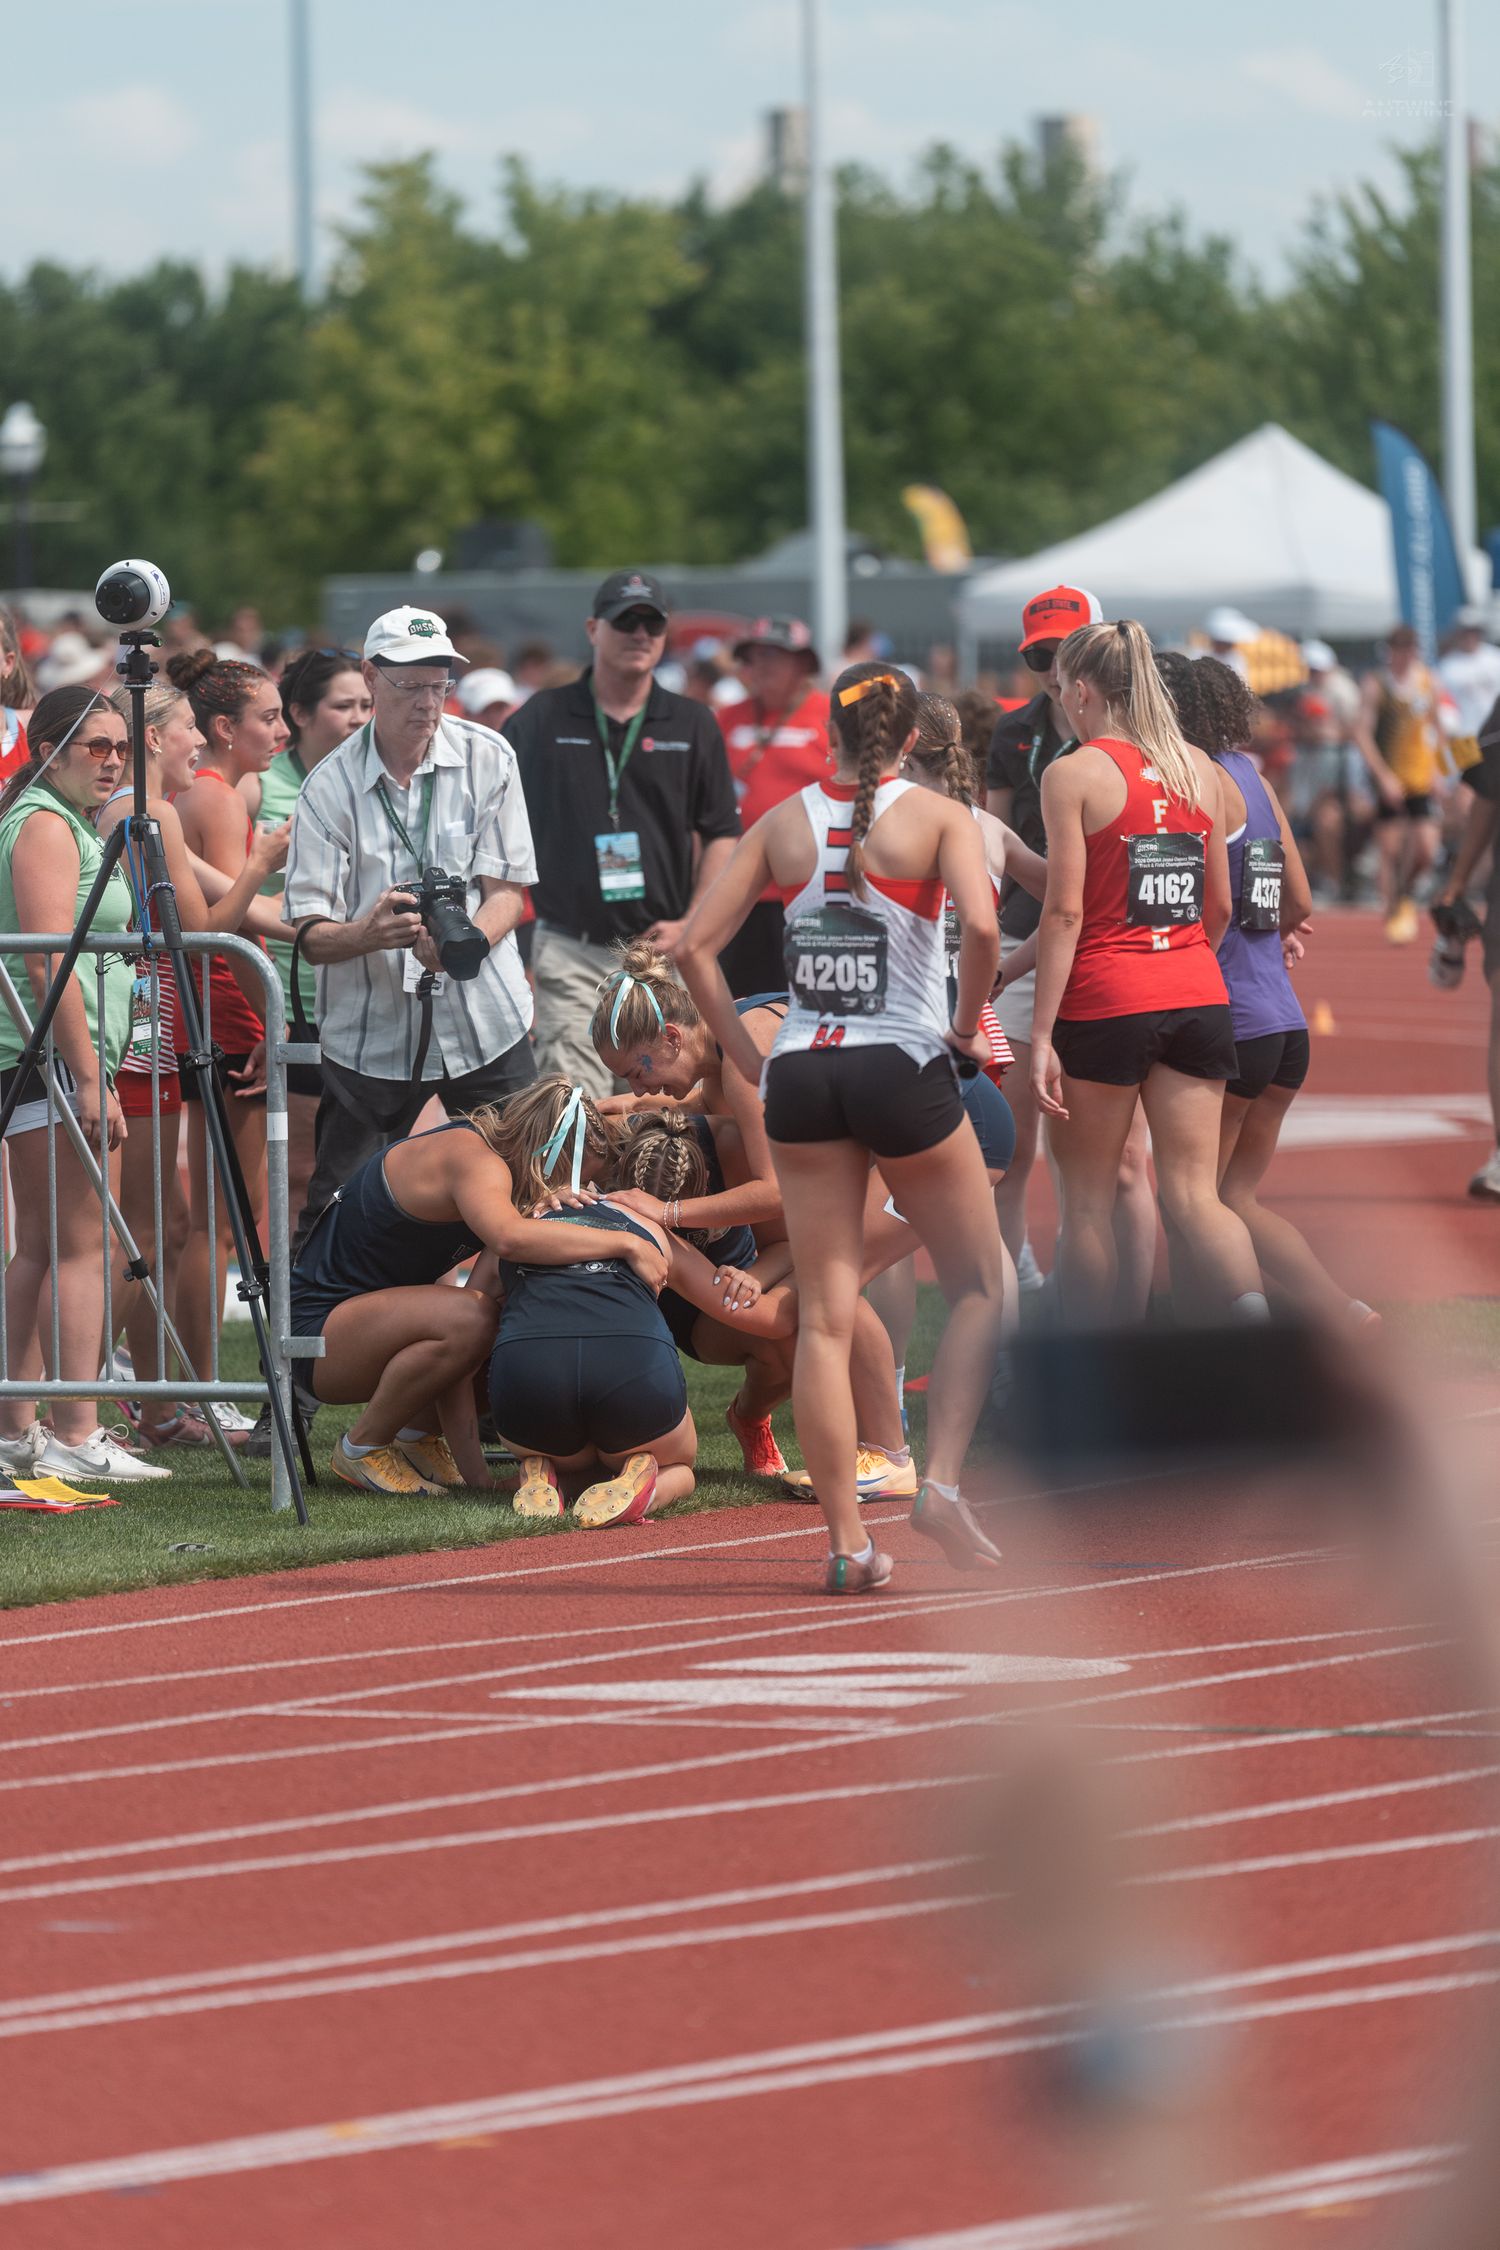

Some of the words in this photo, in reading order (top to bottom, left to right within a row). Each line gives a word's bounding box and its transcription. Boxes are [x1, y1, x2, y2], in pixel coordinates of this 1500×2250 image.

[1138, 872, 1195, 905] 4162
[1251, 877, 1281, 909] 4375
[795, 954, 878, 992] 4205
